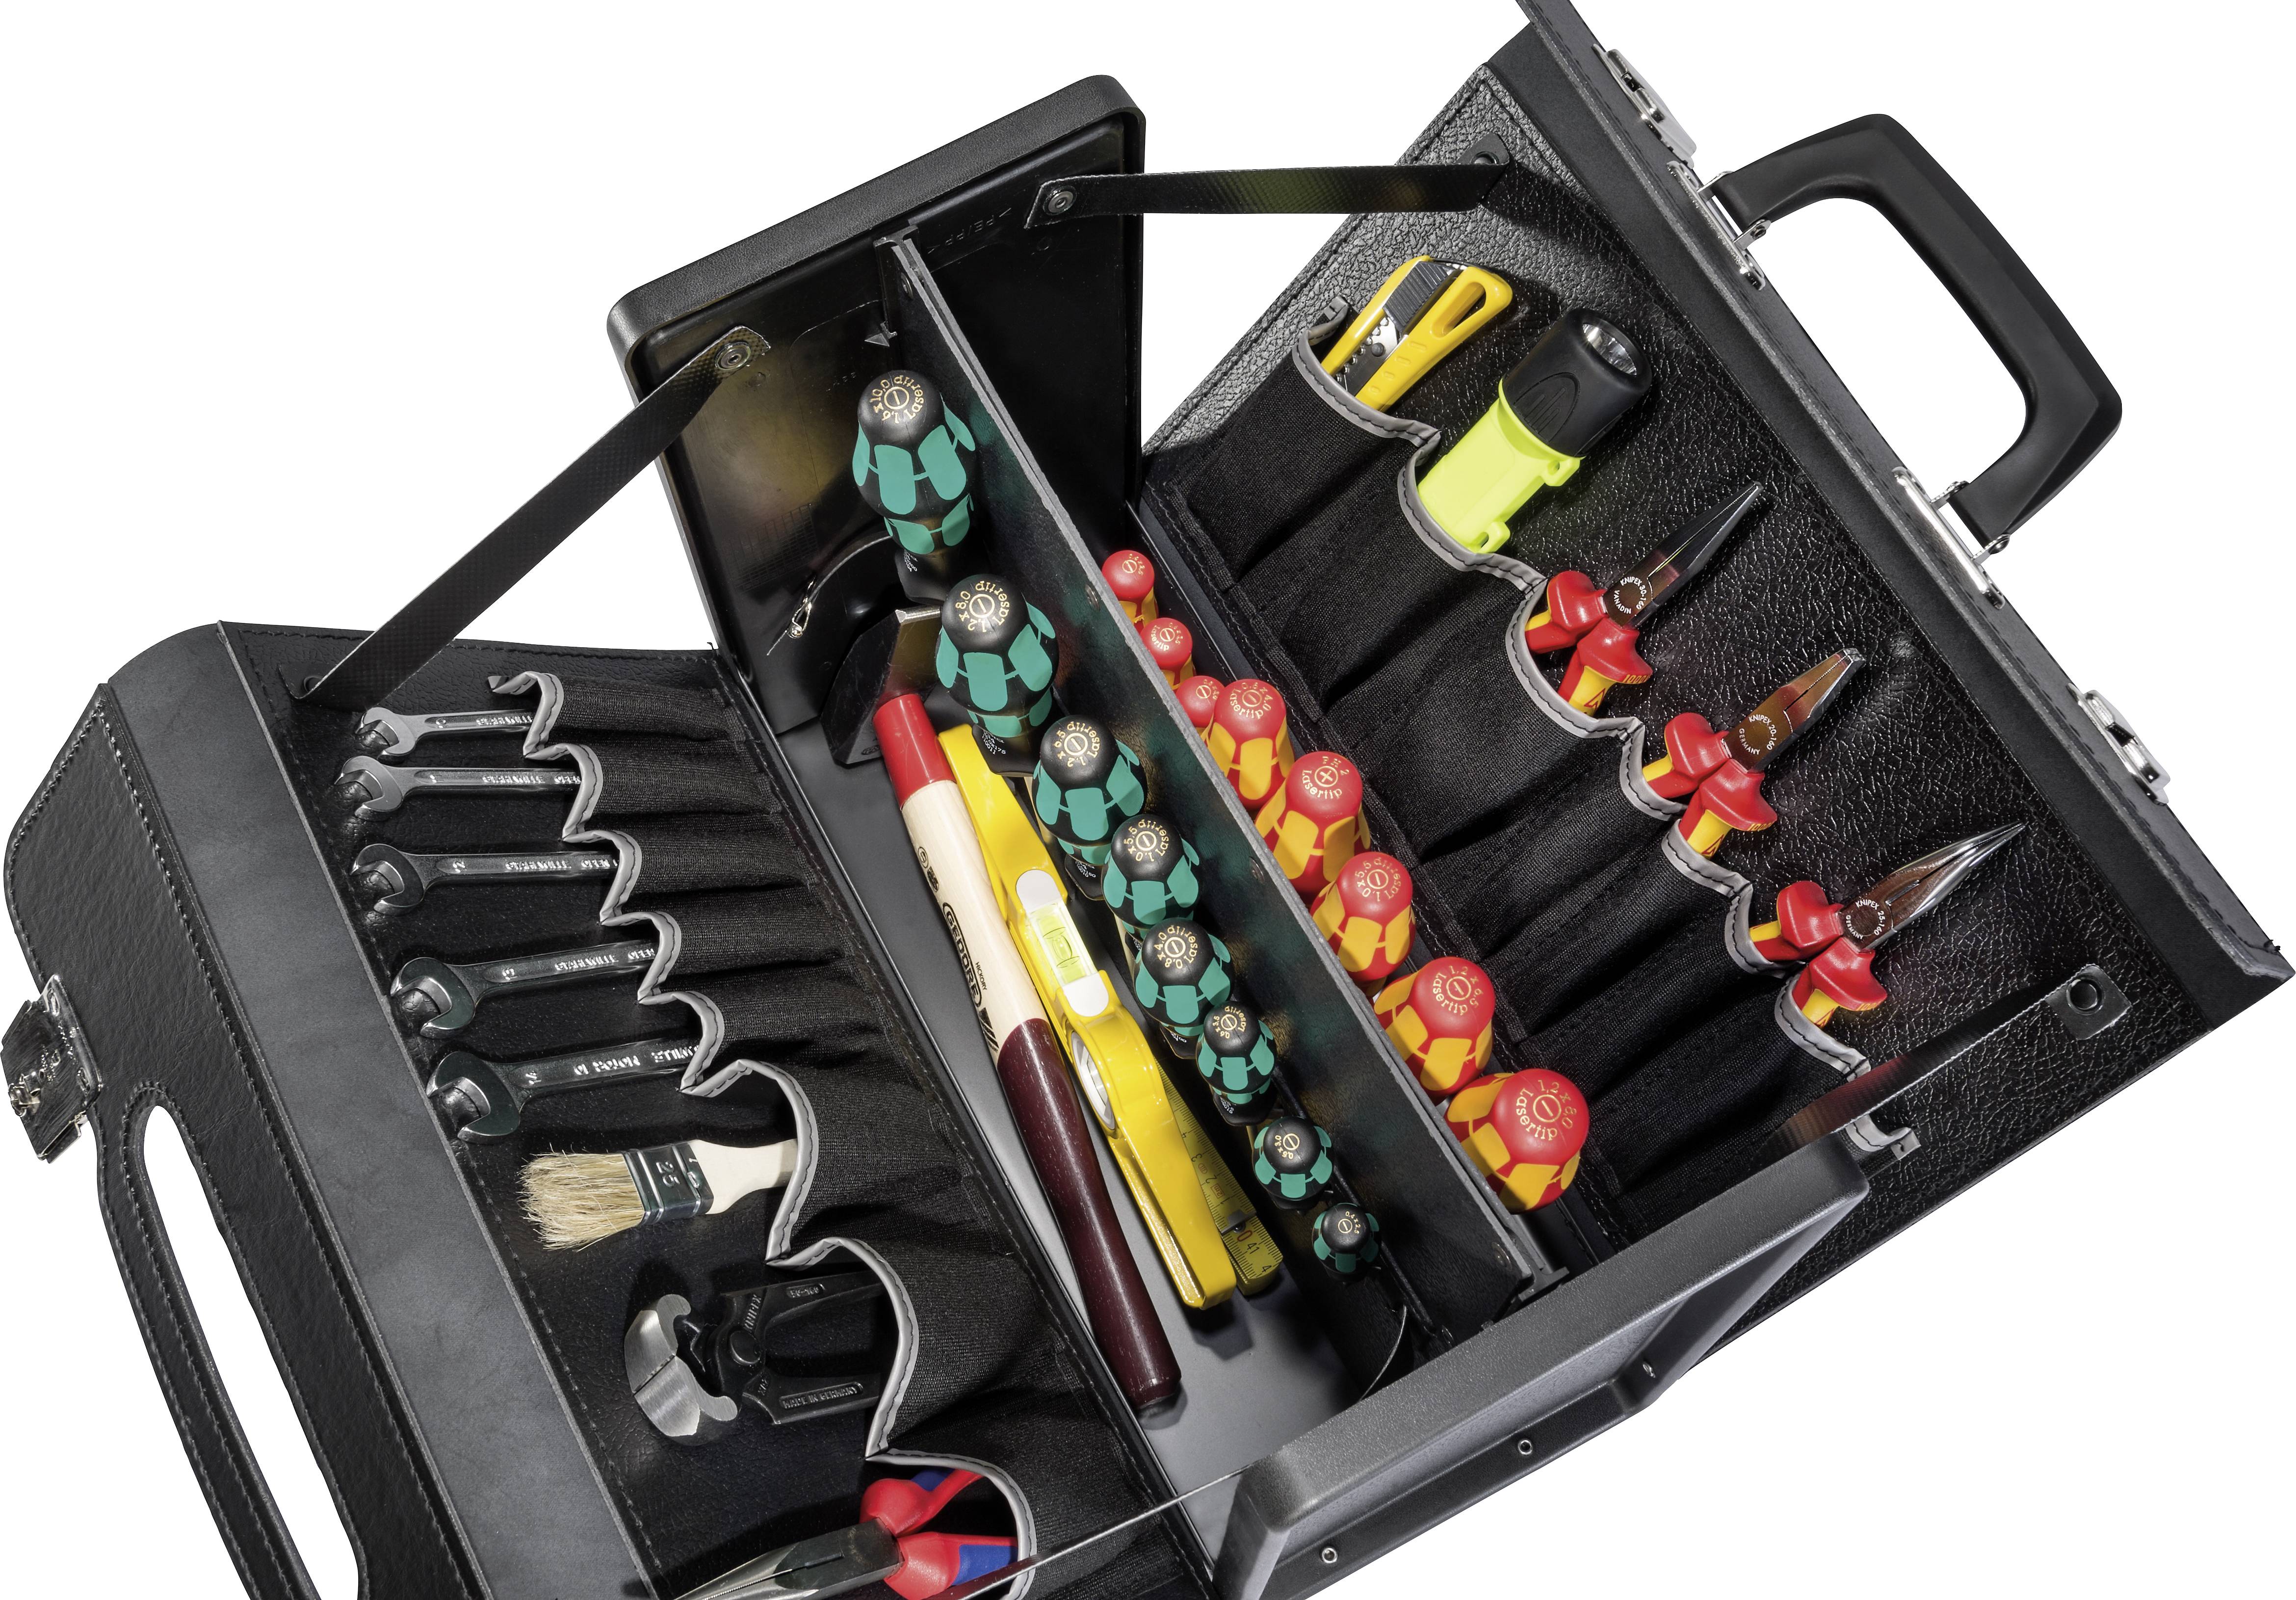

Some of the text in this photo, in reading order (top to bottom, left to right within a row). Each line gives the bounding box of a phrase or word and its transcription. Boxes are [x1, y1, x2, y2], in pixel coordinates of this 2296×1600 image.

[893, 375, 924, 420] Lasertip
[975, 581, 1010, 625] Lasertip
[1614, 590, 1631, 614] VANADIN
[1620, 576, 1647, 609] KNIPEX 30-160
[1151, 625, 1170, 651] Lasertip
[1230, 688, 1263, 719] Lasertip
[1067, 721, 1100, 758] Lasertip
[1739, 728, 1760, 755] GERMANY
[1748, 714, 1776, 750] KNIPEX 20-160
[1302, 769, 1342, 799] Lasertip
[1138, 819, 1169, 856] Lasertip
[1374, 857, 1401, 899] Lasertip
[1846, 915, 1863, 940] GERMANY
[1855, 899, 1885, 935] KNIPEX 25-160
[946, 911, 979, 998] GEDORE
[1167, 925, 1198, 964] Lasertip
[975, 962, 988, 991] HICKORY
[1433, 972, 1468, 1016] Lasertip
[1225, 1006, 1247, 1032] Lasertip
[593, 1055, 640, 1072] MOTOR
[1516, 1088, 1558, 1141] Lasertip
[1191, 1154, 1202, 1162] 3
[655, 1162, 680, 1188] 25
[1205, 1175, 1217, 1184] 2
[1247, 1242, 1259, 1254] 41
